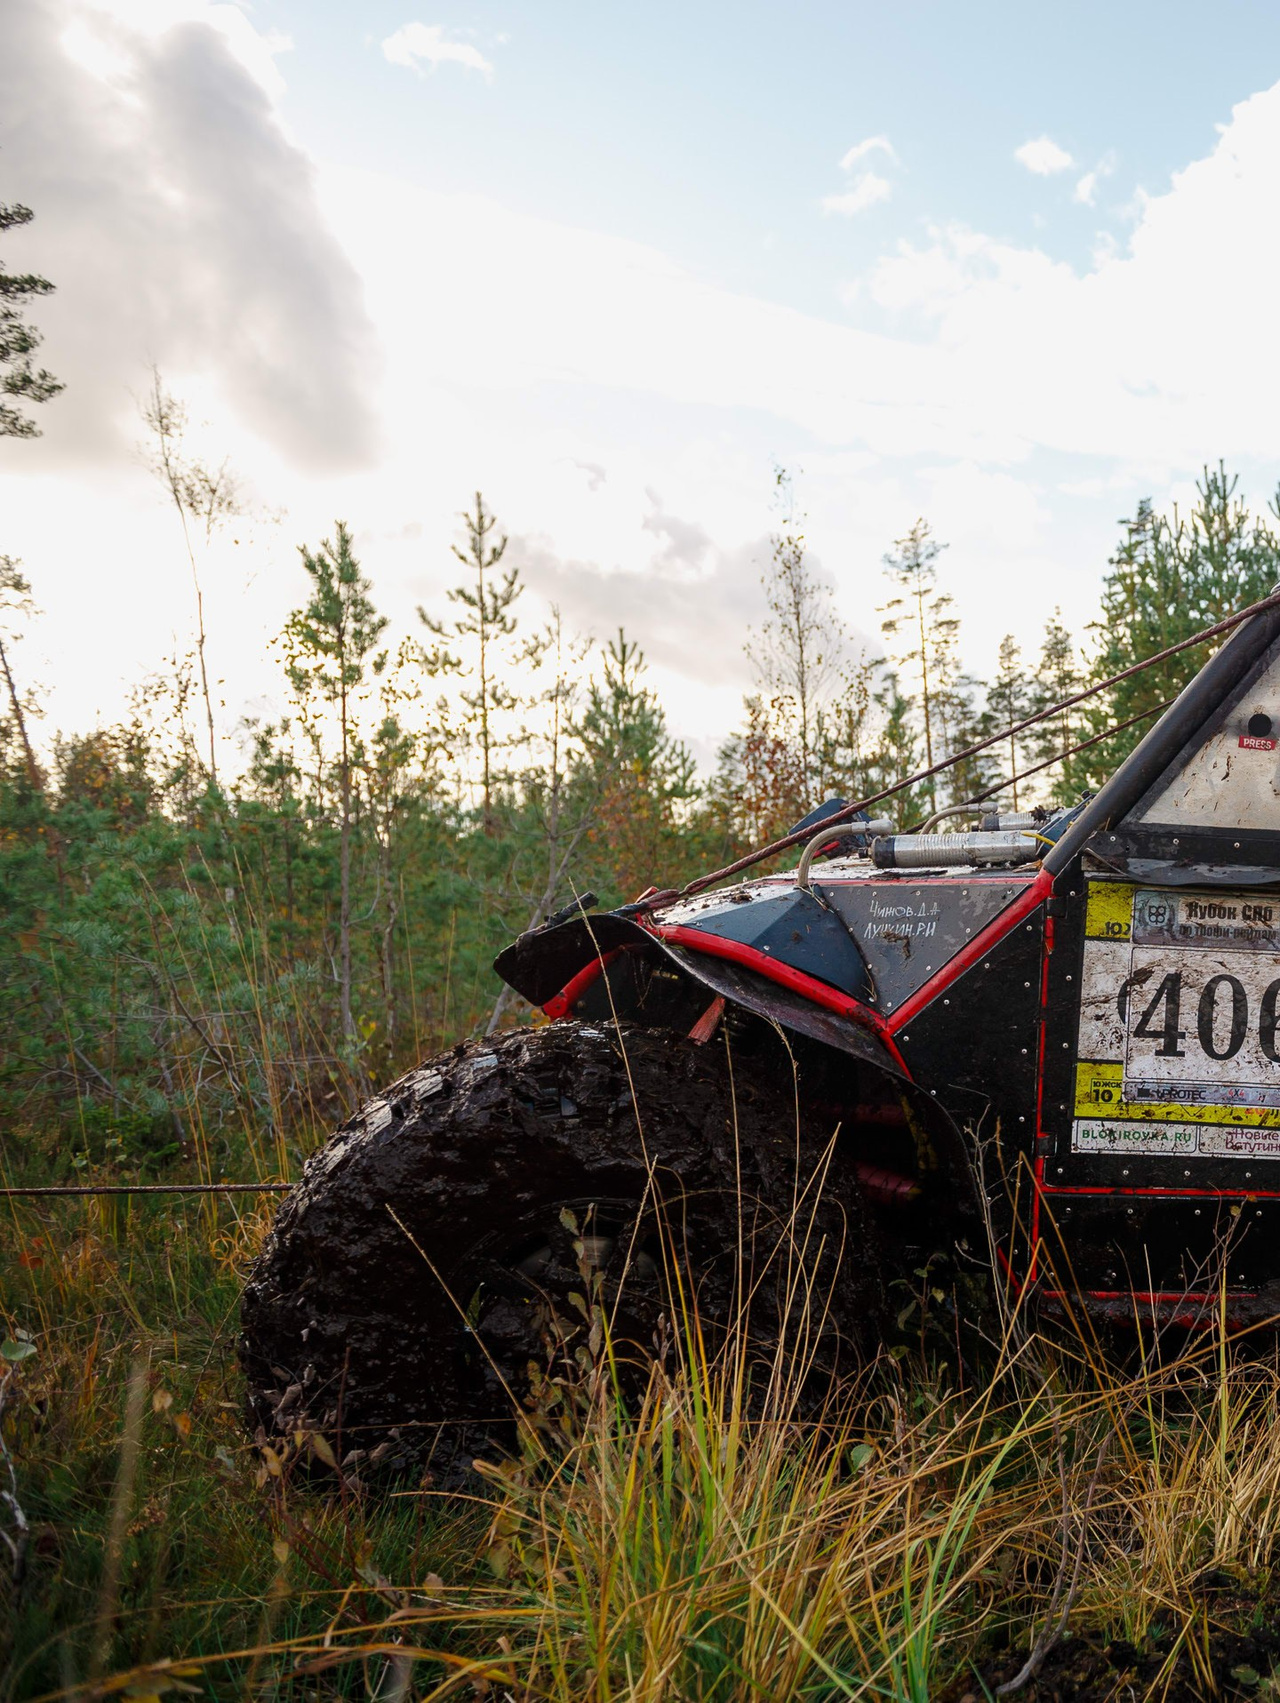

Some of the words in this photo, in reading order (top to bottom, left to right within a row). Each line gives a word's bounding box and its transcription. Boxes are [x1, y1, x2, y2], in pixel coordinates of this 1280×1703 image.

[1243, 738, 1272, 749] PRESS
[1187, 901, 1237, 920] Кубок
[1093, 1089, 1113, 1102] 10
[1082, 1129, 1192, 1142] BLOKIROVKA.RU
